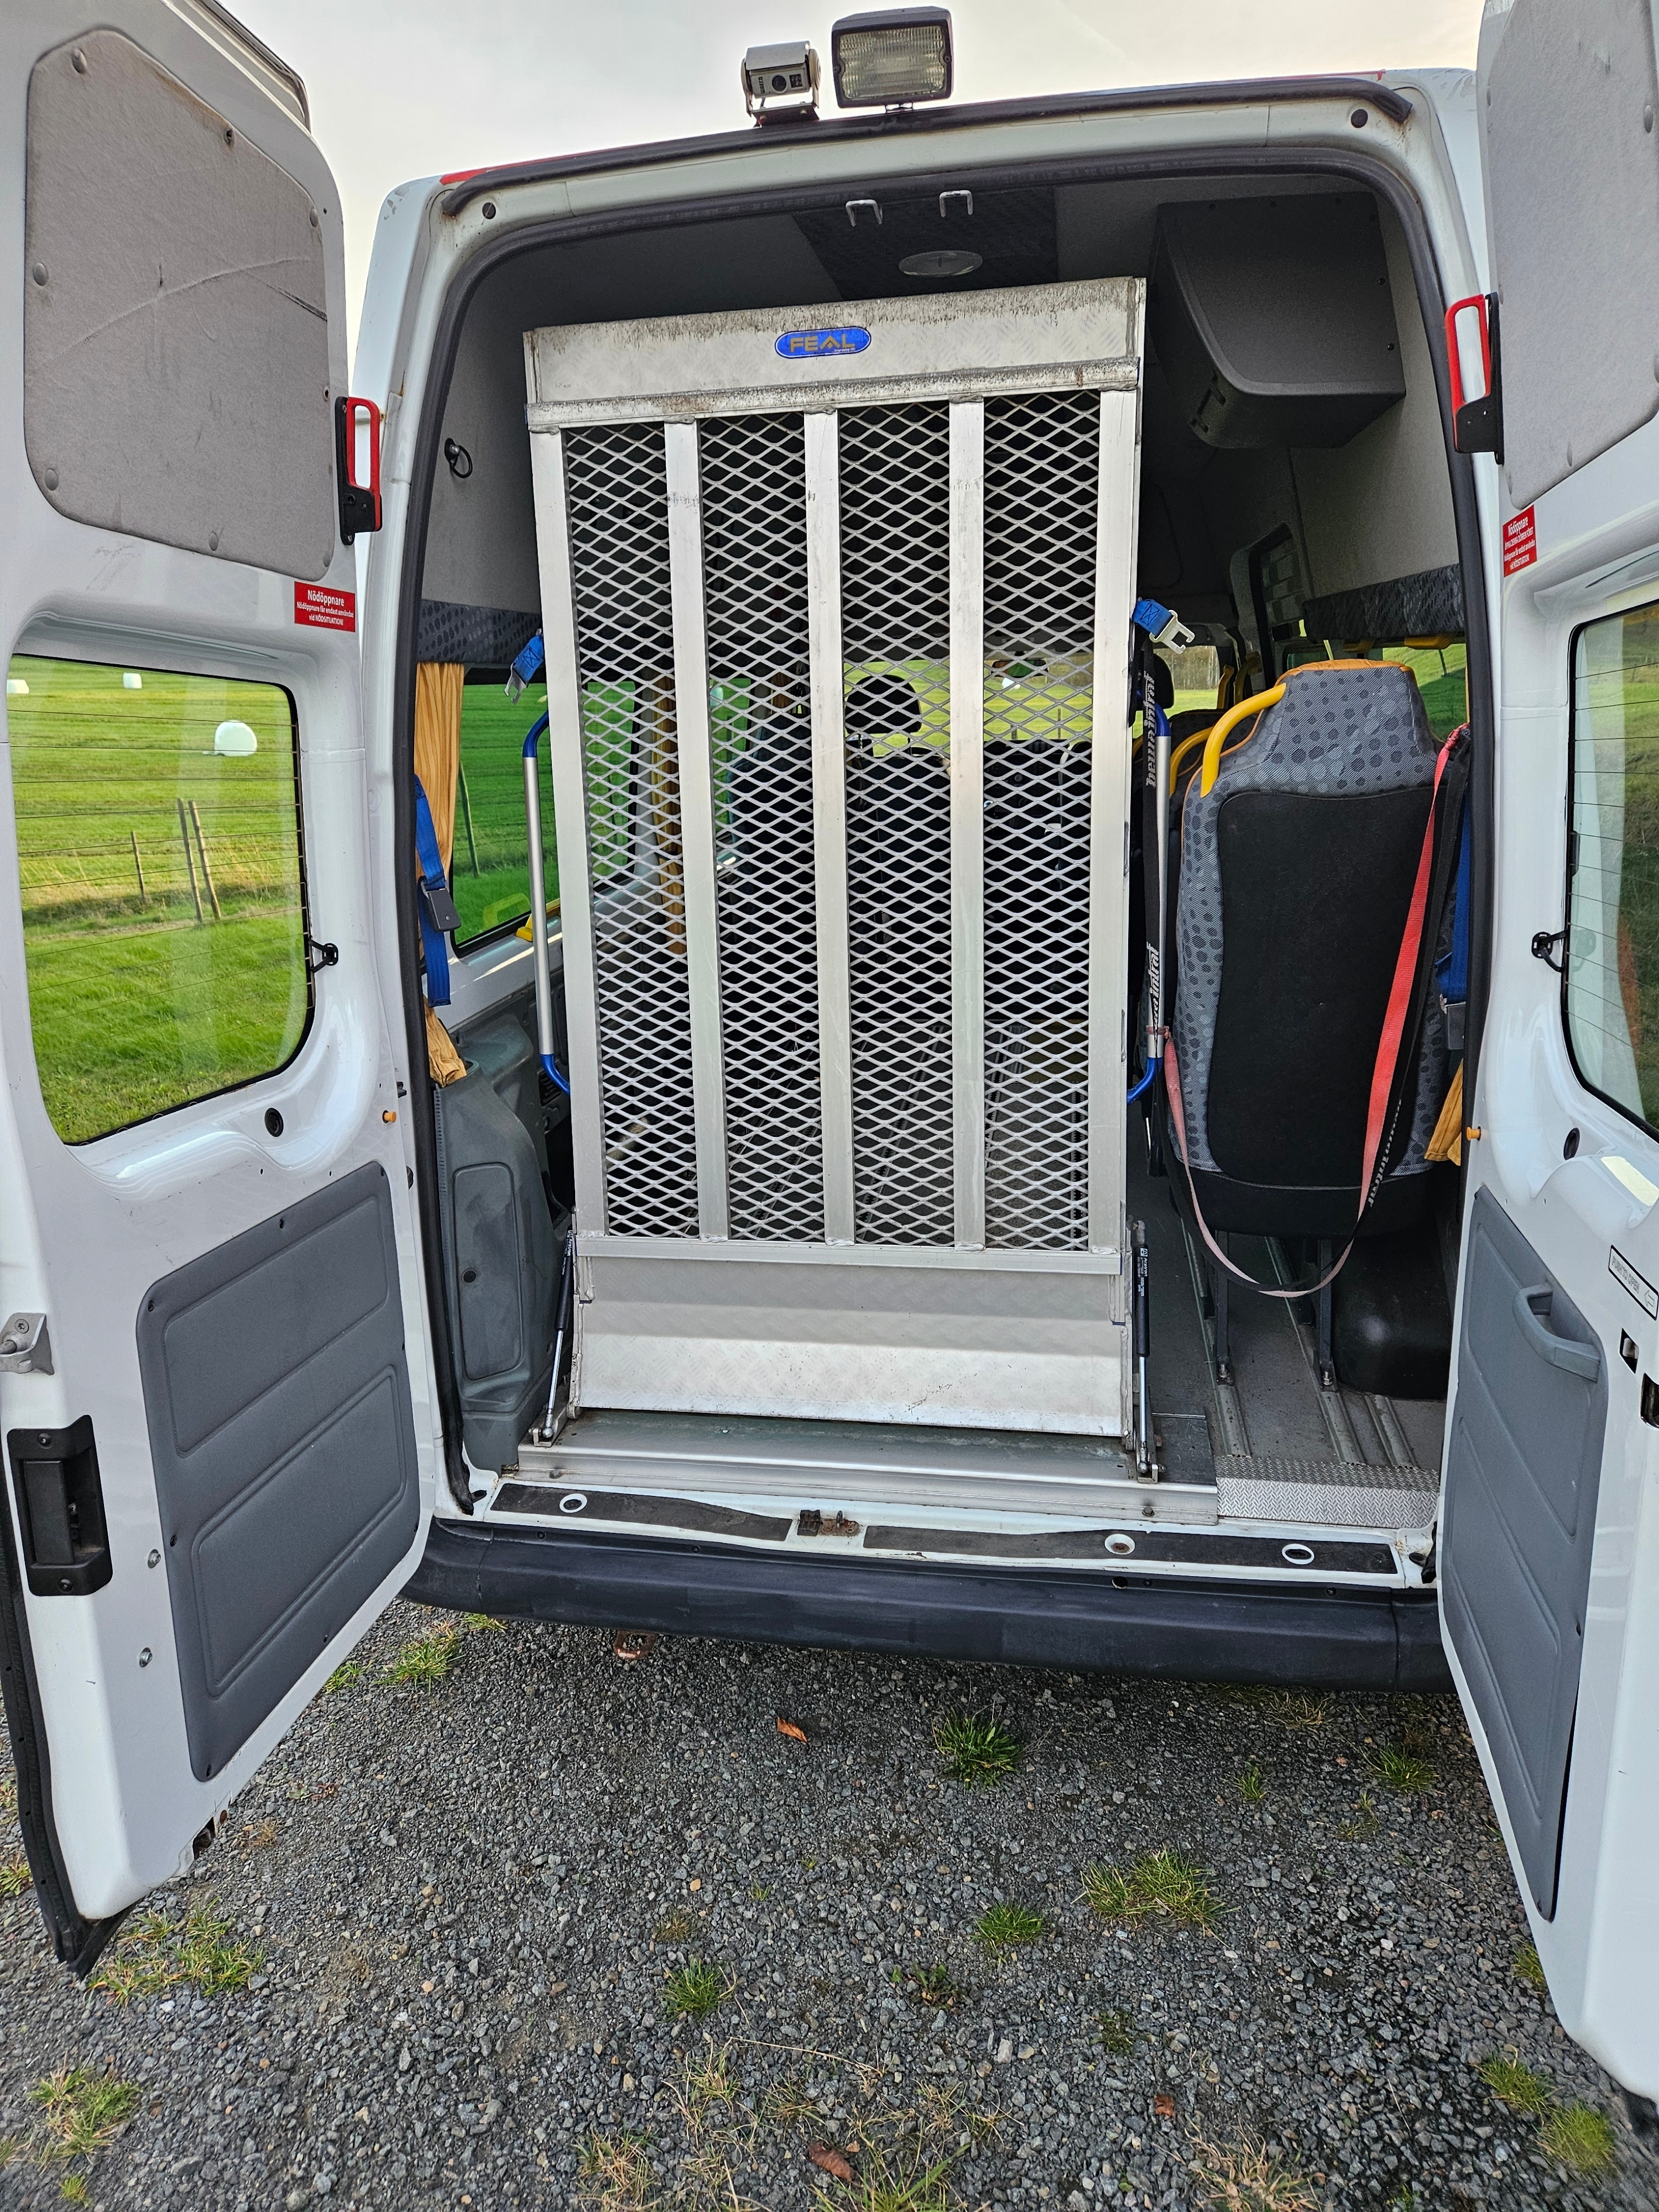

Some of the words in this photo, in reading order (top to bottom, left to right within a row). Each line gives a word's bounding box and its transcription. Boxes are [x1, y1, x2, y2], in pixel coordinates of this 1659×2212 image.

[790, 333, 855, 353] FEAL
[307, 589, 344, 607] Nödöppnare
[296, 601, 320, 612] Nödöppnare
[325, 607, 338, 615] endast
[338, 609, 354, 618] användas
[1621, 1265, 1628, 1280] TO
[1628, 1274, 1640, 1294] OPEN
